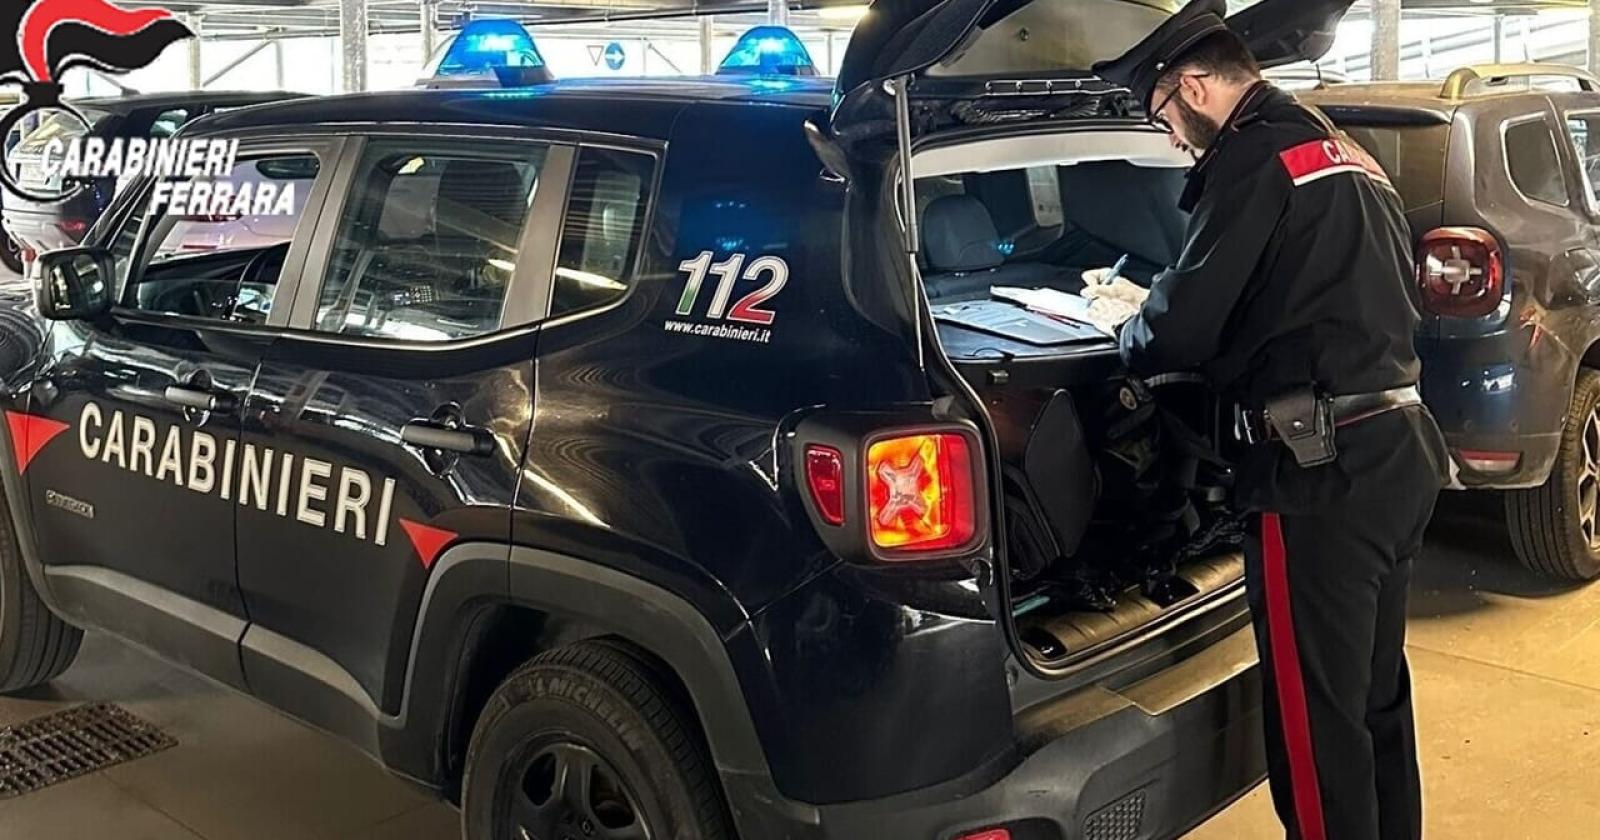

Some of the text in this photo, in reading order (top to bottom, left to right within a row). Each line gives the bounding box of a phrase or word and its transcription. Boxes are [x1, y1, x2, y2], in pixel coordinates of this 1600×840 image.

[675, 250, 790, 325] 112
[664, 319, 772, 344] www.carabinieri.it
[78, 400, 397, 547] CARABINIERI
